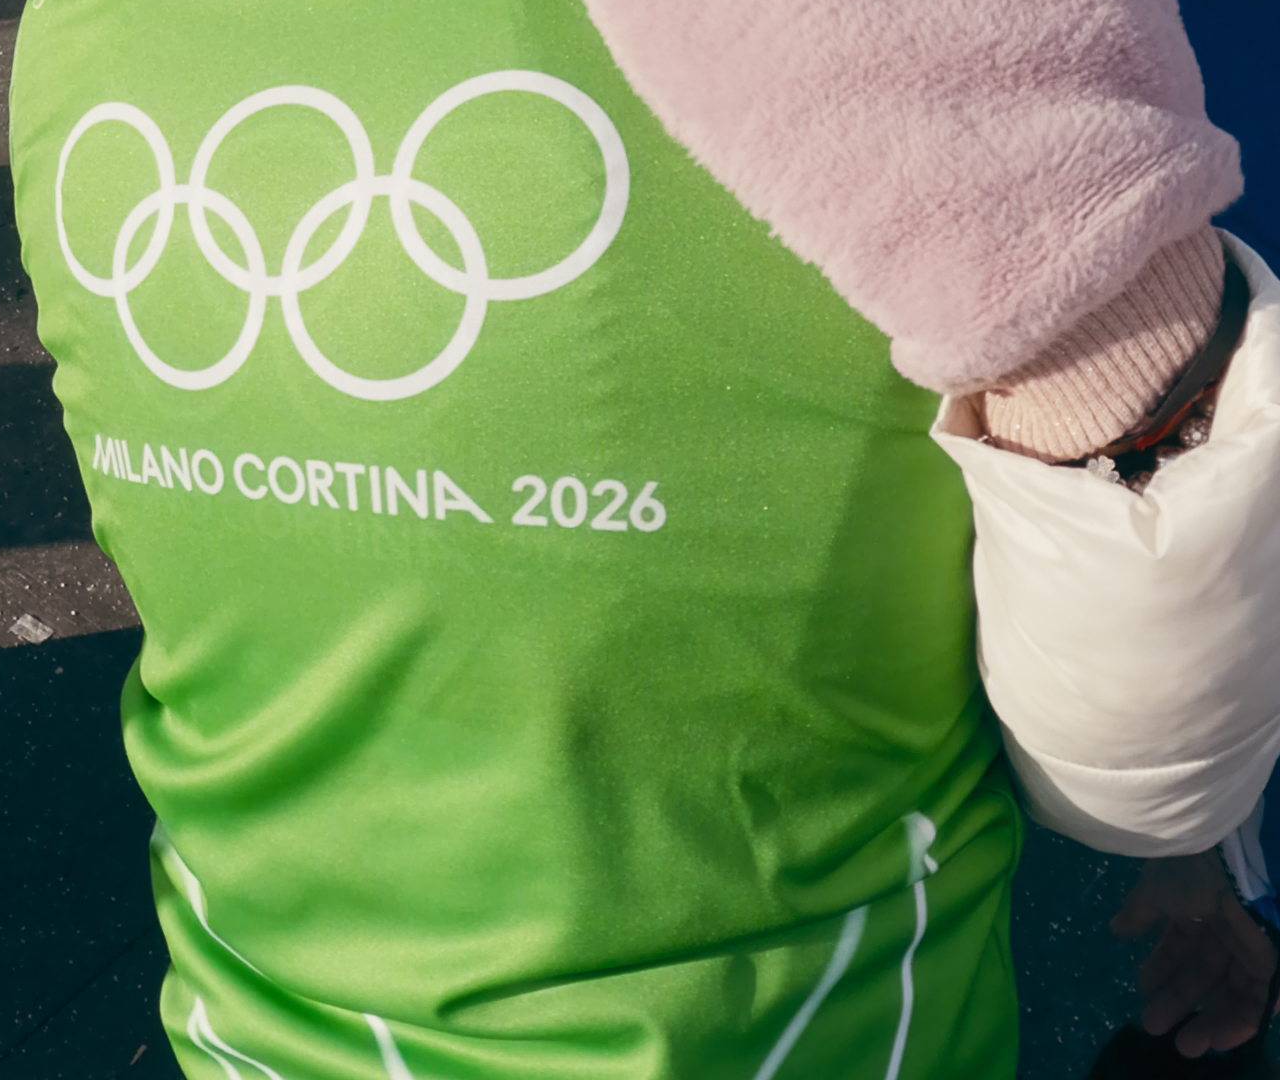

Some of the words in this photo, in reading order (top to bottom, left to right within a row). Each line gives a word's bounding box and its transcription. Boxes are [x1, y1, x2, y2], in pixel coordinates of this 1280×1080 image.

[92, 433, 221, 496] MILANO
[233, 452, 494, 525] CORTINA
[510, 474, 667, 533] 2026
